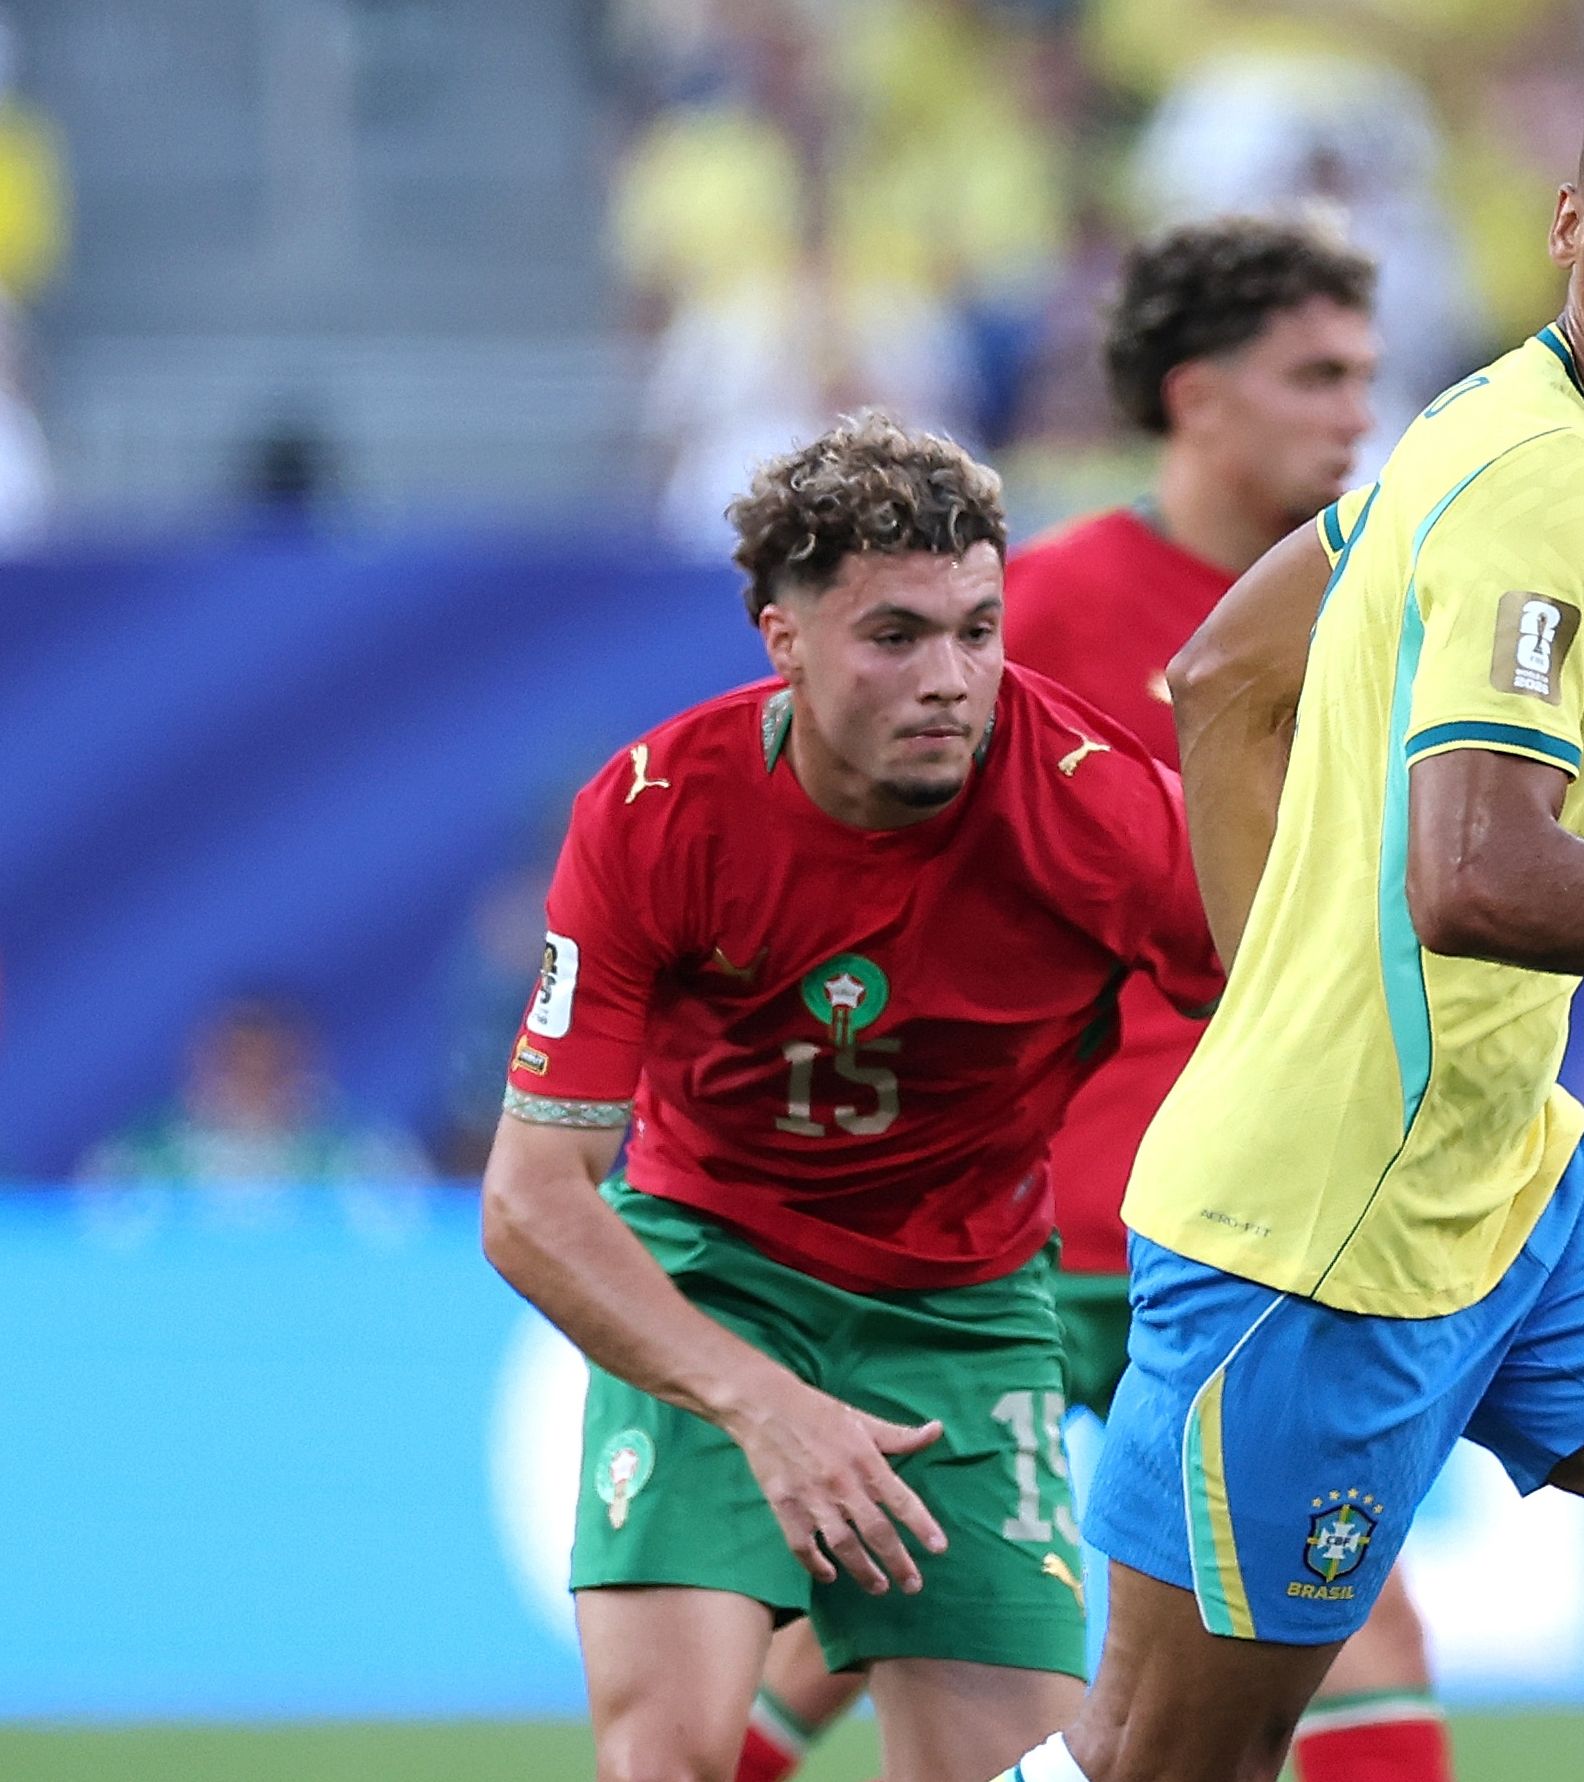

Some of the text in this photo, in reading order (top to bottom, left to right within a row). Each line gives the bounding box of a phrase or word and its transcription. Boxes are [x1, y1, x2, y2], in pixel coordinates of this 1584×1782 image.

[775, 1037, 900, 1137] 15
[1326, 1535, 1351, 1547] CBF
[1287, 1582, 1354, 1600] BRASIL
